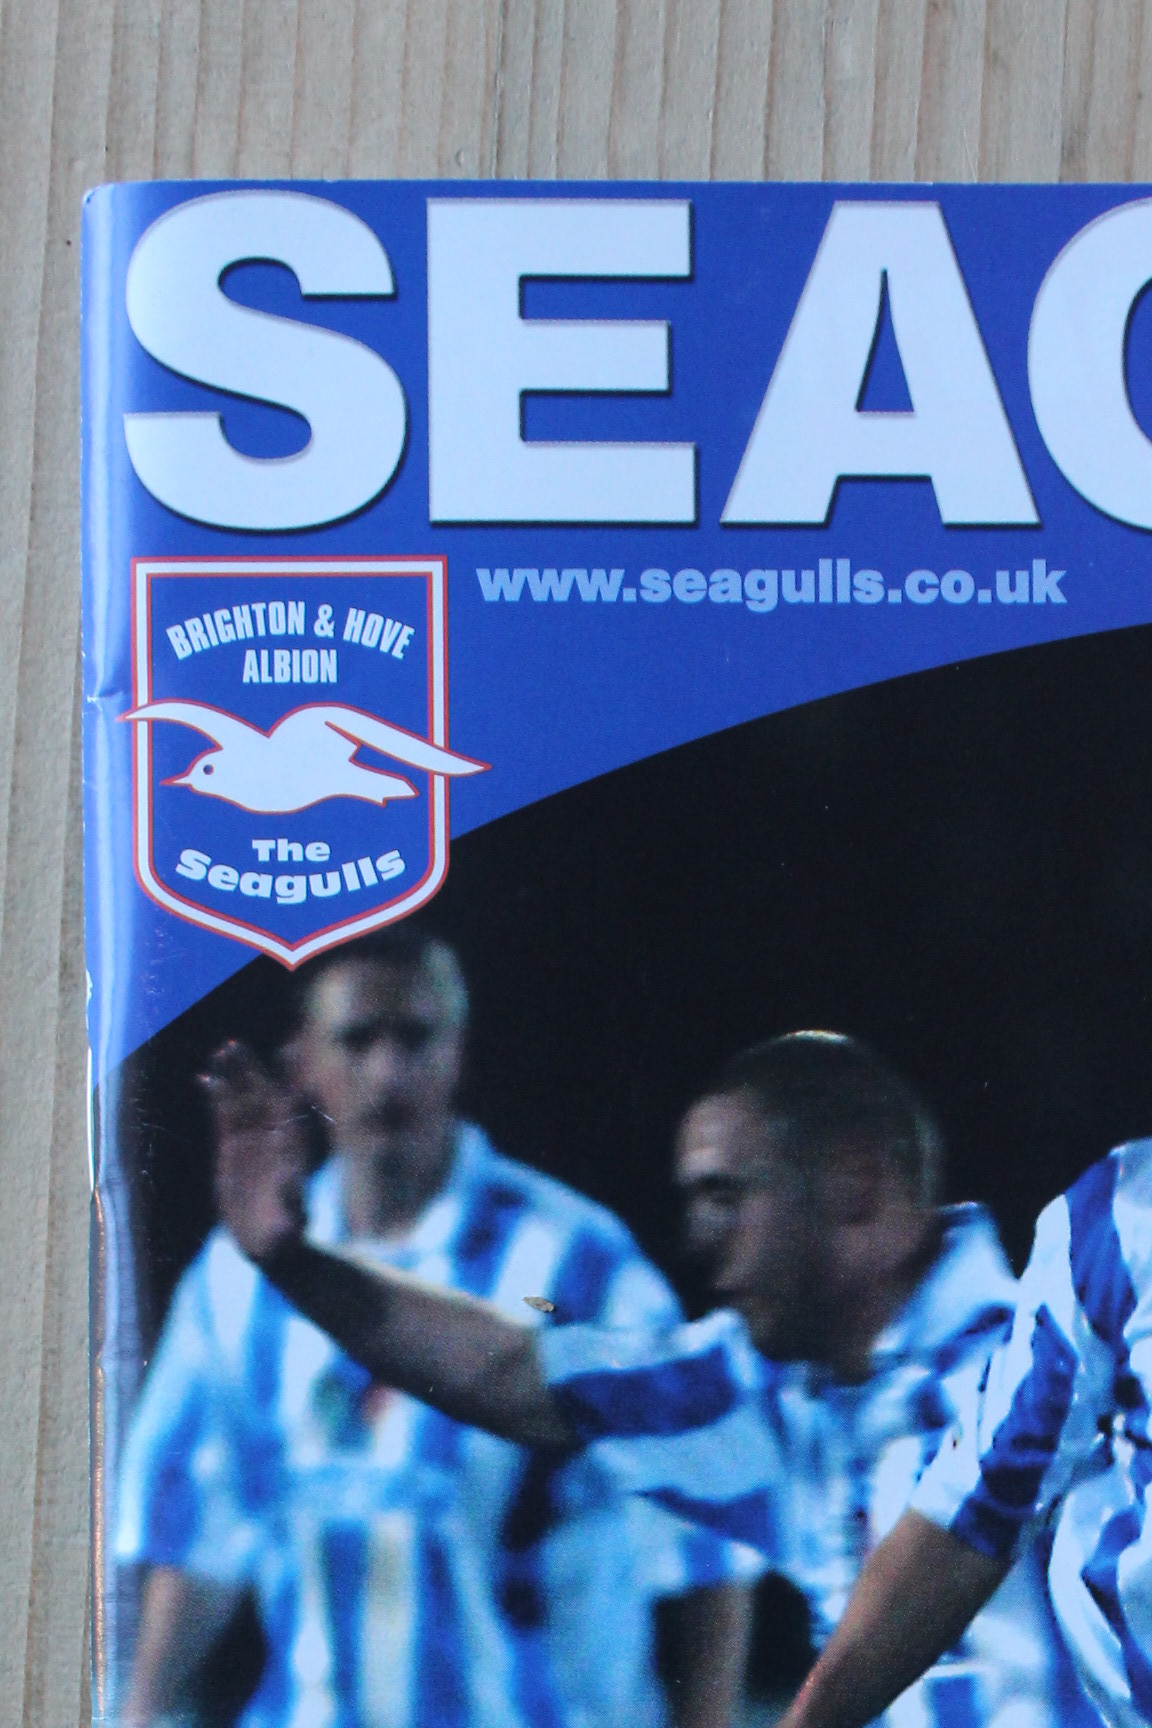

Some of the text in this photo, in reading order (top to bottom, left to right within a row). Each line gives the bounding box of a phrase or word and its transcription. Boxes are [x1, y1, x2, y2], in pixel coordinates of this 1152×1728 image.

[476, 558, 1067, 613] www.seagulls.co.uk
[166, 601, 415, 660] BRIGHTON & HOVE
[242, 649, 338, 683] ALBION
[176, 849, 406, 904] Seagulls
[252, 838, 330, 862] The
